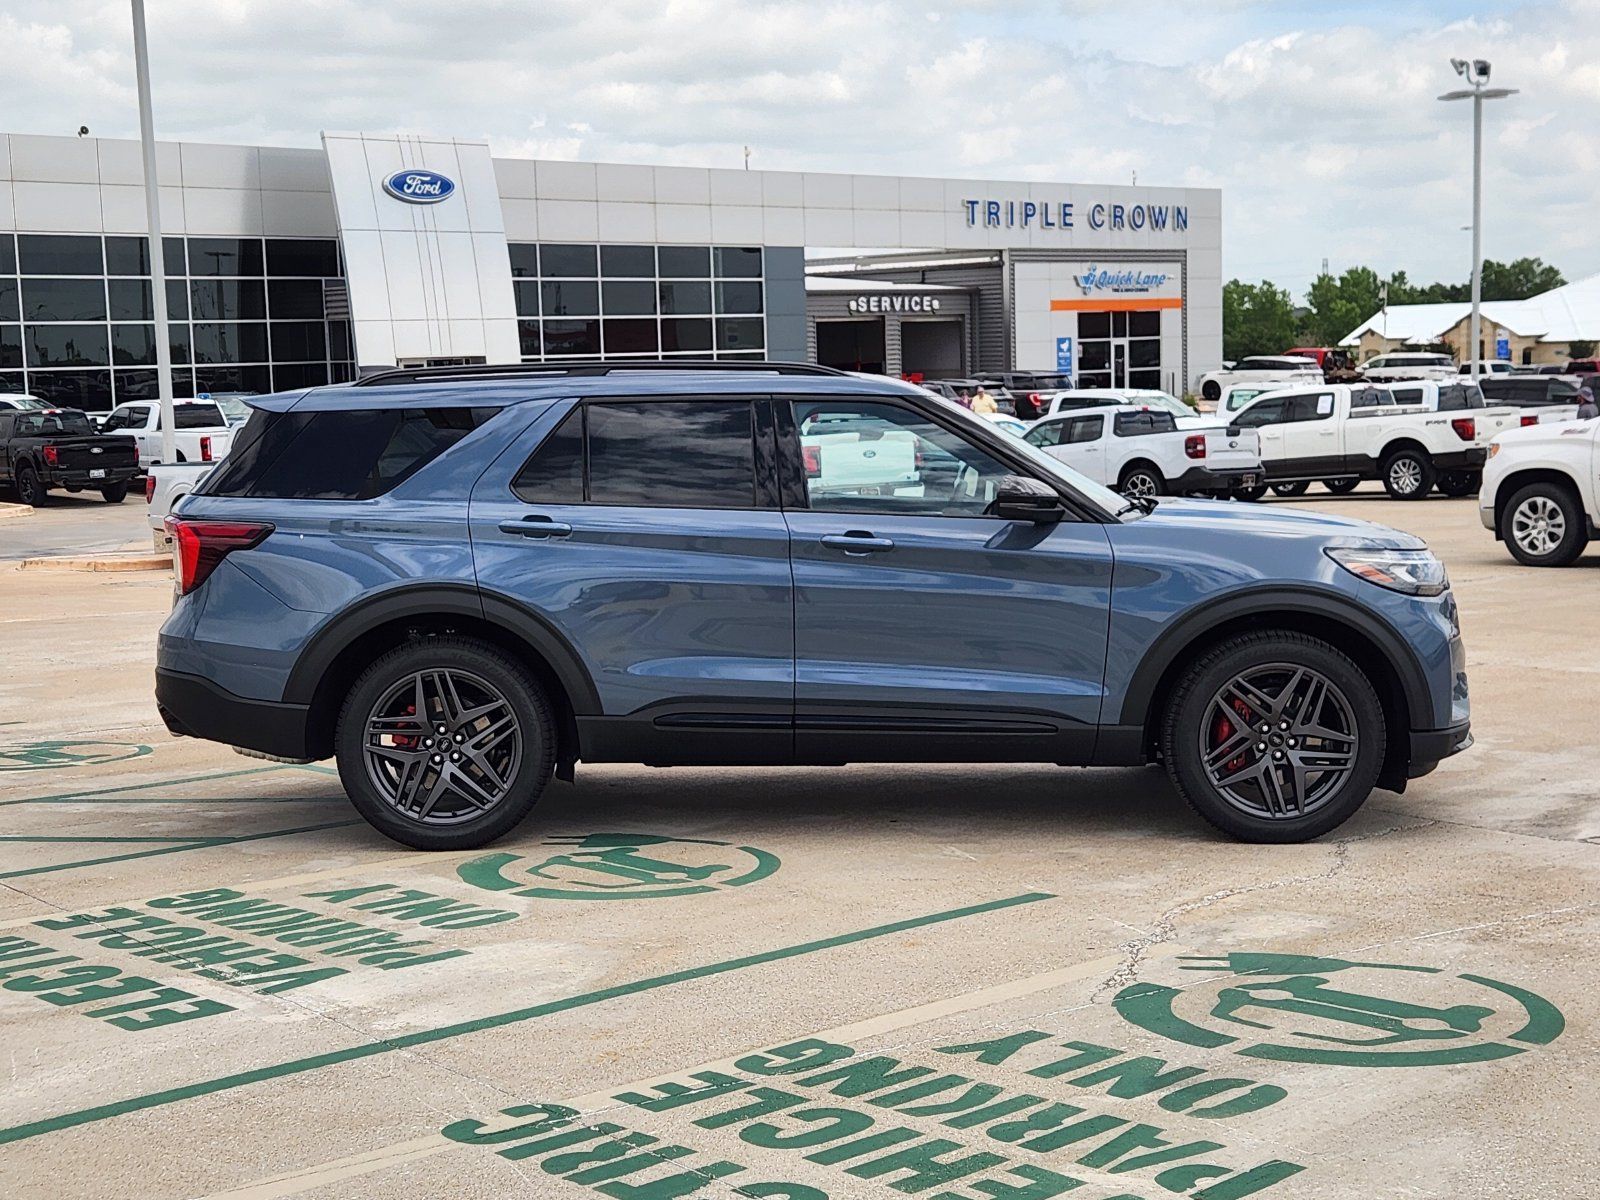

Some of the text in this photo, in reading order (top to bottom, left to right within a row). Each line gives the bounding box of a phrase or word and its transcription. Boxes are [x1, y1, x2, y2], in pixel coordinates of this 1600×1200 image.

[403, 174, 442, 195] Ford
[965, 200, 1189, 230] TRIPLE CROWN
[857, 295, 932, 312] SERVICE
[1097, 269, 1167, 288] Quick Lane
[145, 887, 471, 970] PARKING
[301, 883, 520, 930] ONLY
[31, 907, 351, 995] VEHICLE
[931, 1029, 1289, 1119] ONLY
[610, 1070, 1149, 1200] EHICLE
[733, 1037, 1308, 1200] PARKING
